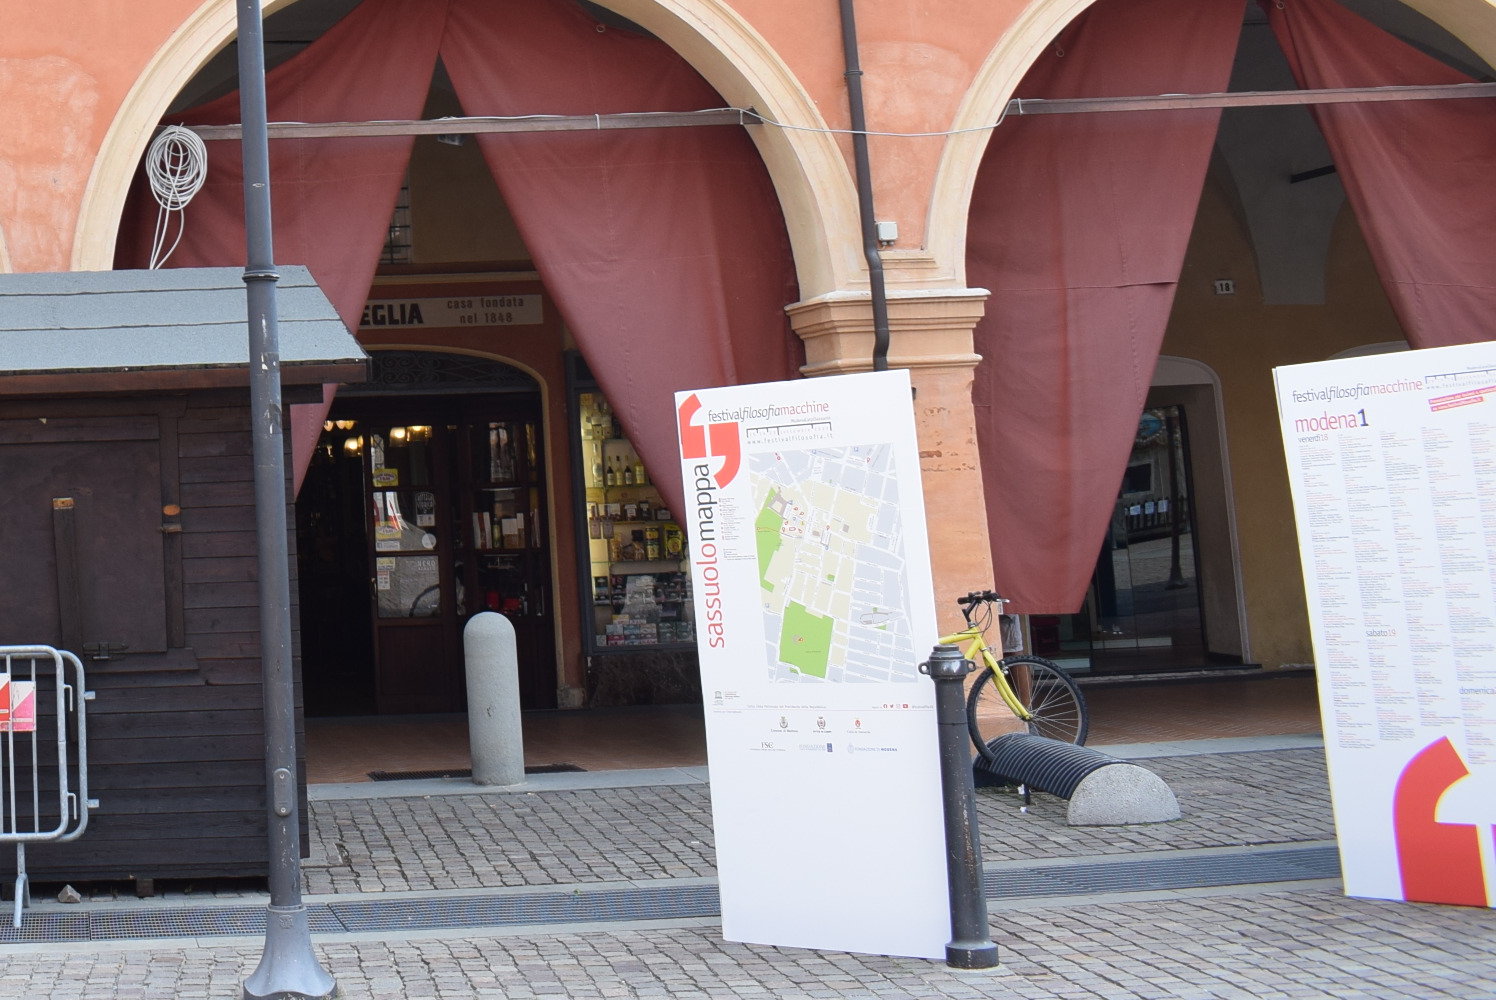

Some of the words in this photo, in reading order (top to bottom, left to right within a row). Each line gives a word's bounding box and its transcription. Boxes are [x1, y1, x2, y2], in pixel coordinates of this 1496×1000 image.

[1219, 282, 1230, 292] 18
[447, 298, 473, 309] casa
[481, 296, 524, 308] fondata
[459, 313, 477, 324] nel
[484, 312, 513, 323] 1848
